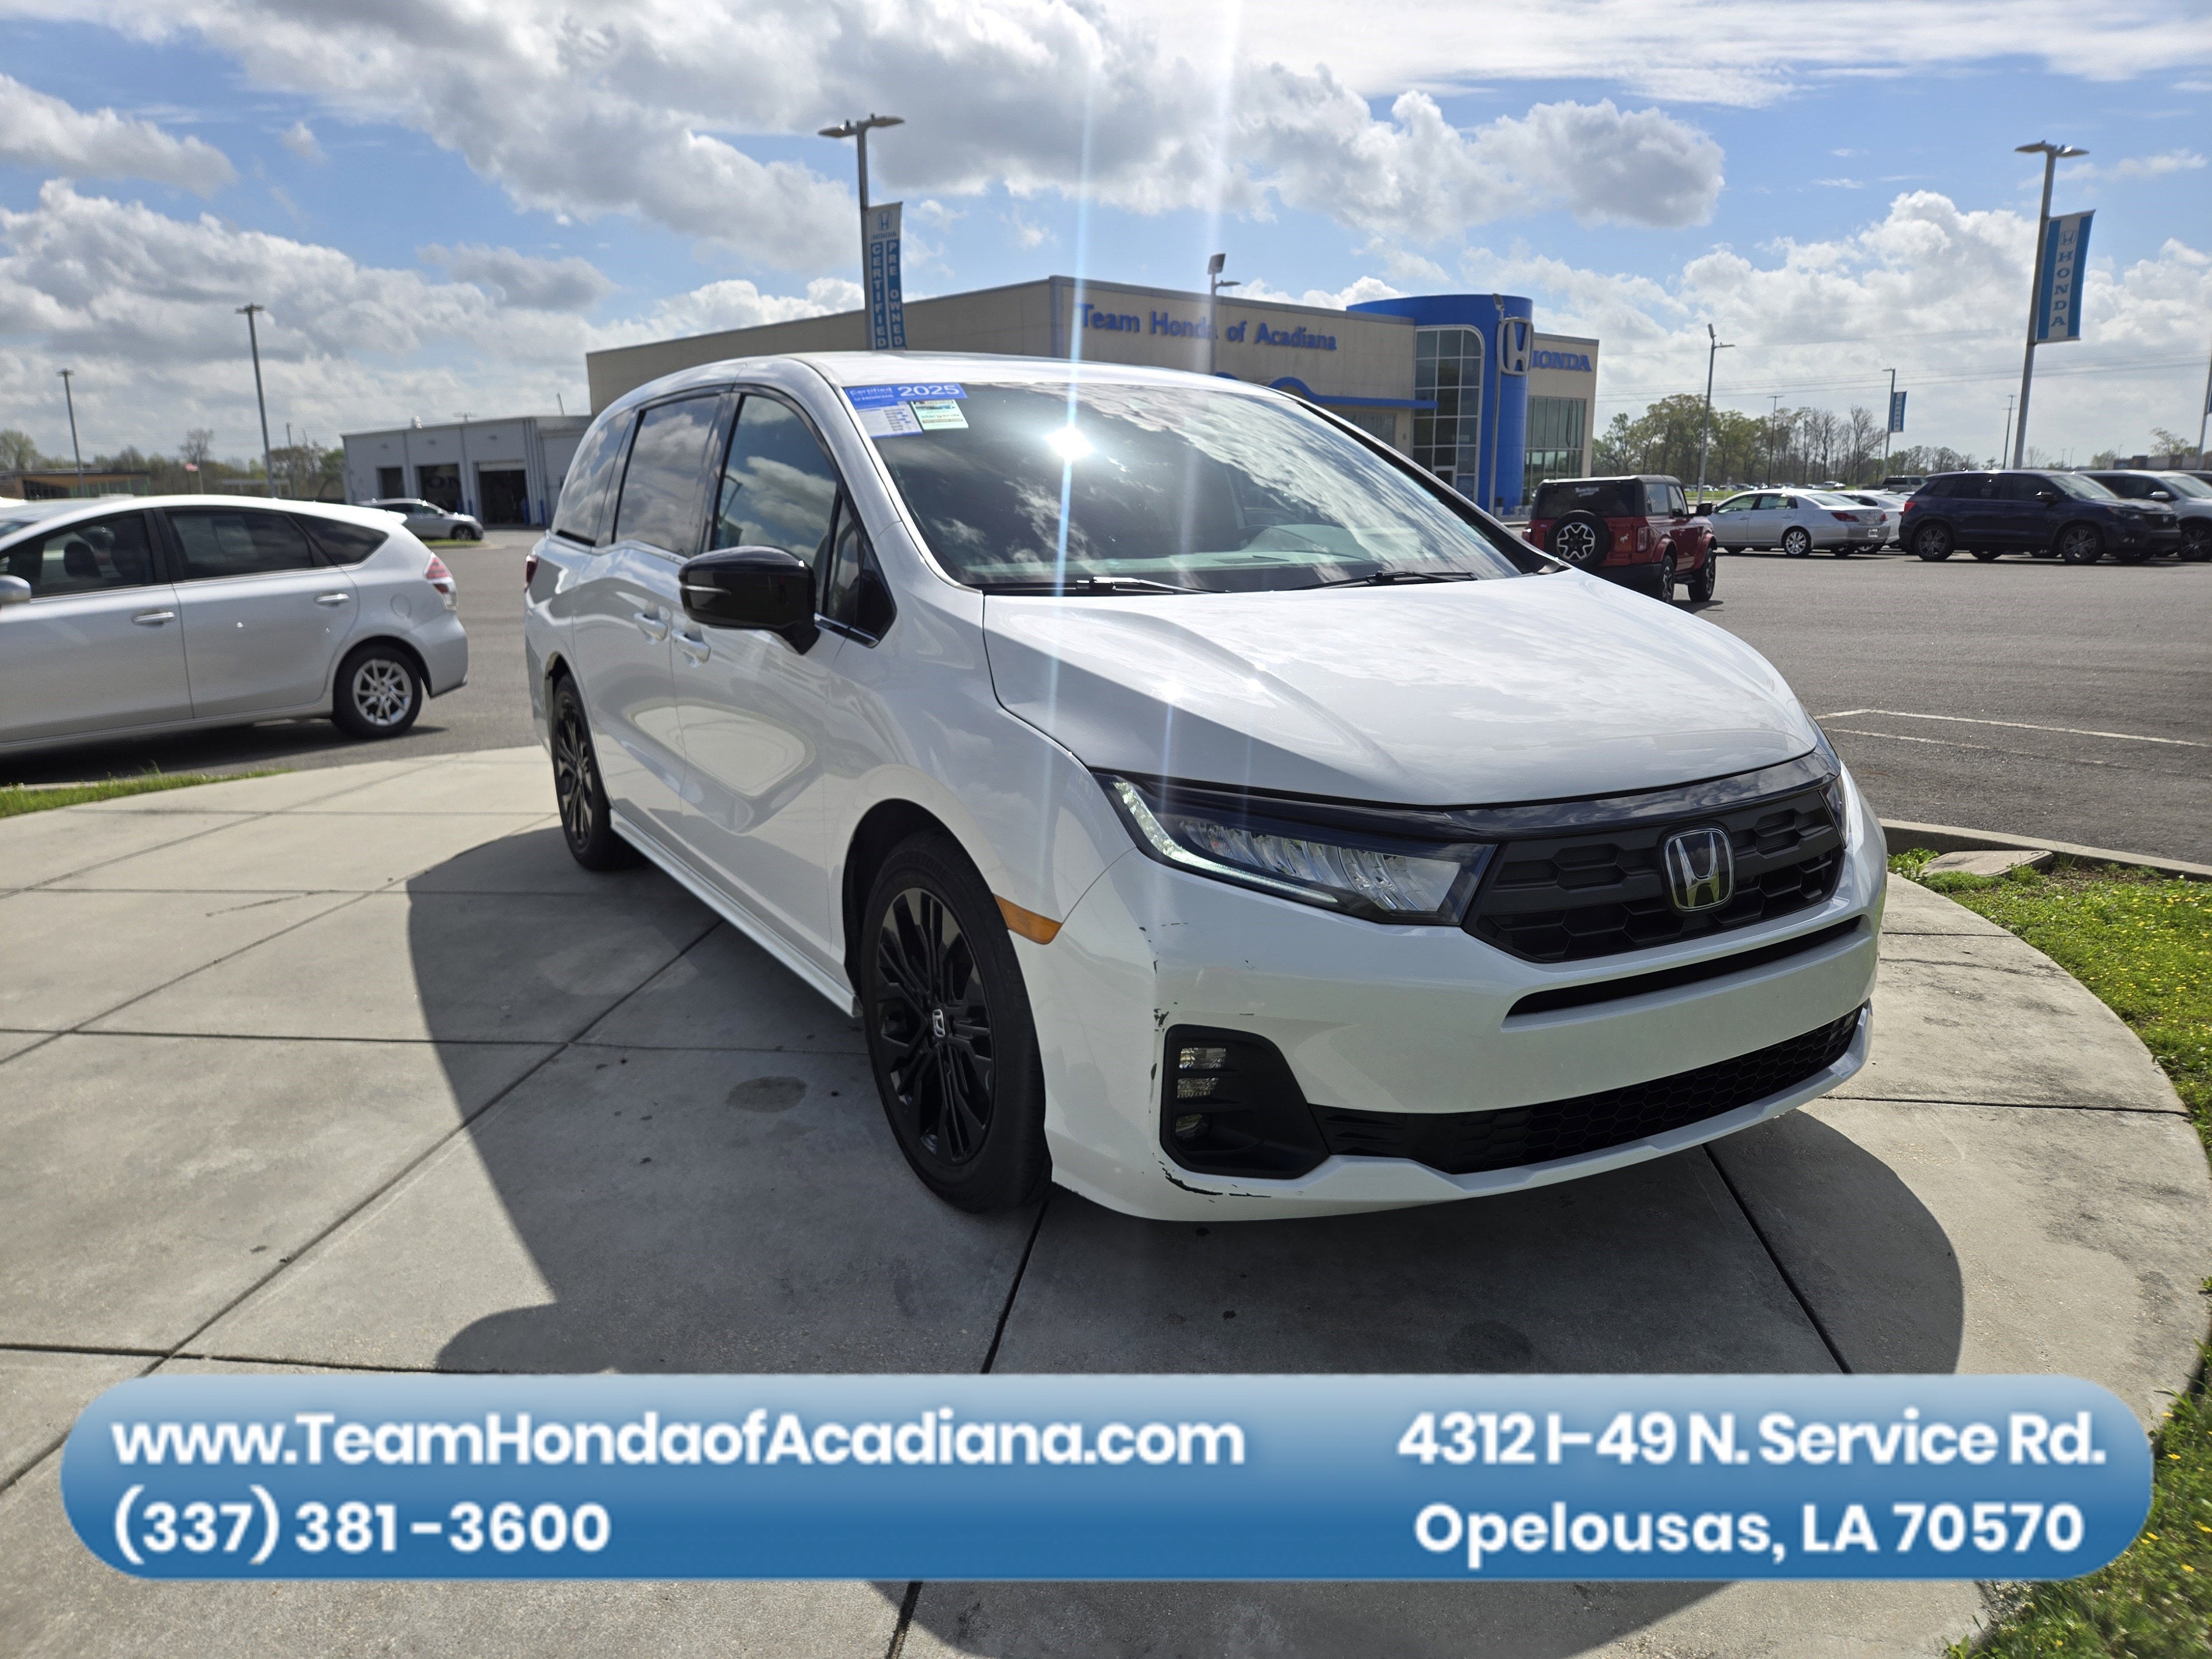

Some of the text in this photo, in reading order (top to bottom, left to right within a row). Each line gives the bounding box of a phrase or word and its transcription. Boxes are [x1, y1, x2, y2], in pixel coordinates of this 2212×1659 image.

[872, 244, 886, 347] CERTIFIED
[888, 242, 904, 346] PRE OWNED
[1078, 303, 1140, 333] Team
[1228, 321, 1248, 343] of
[1255, 322, 1337, 351] Acadiana
[2050, 251, 2073, 327] HONDA
[898, 385, 960, 397] 2025
